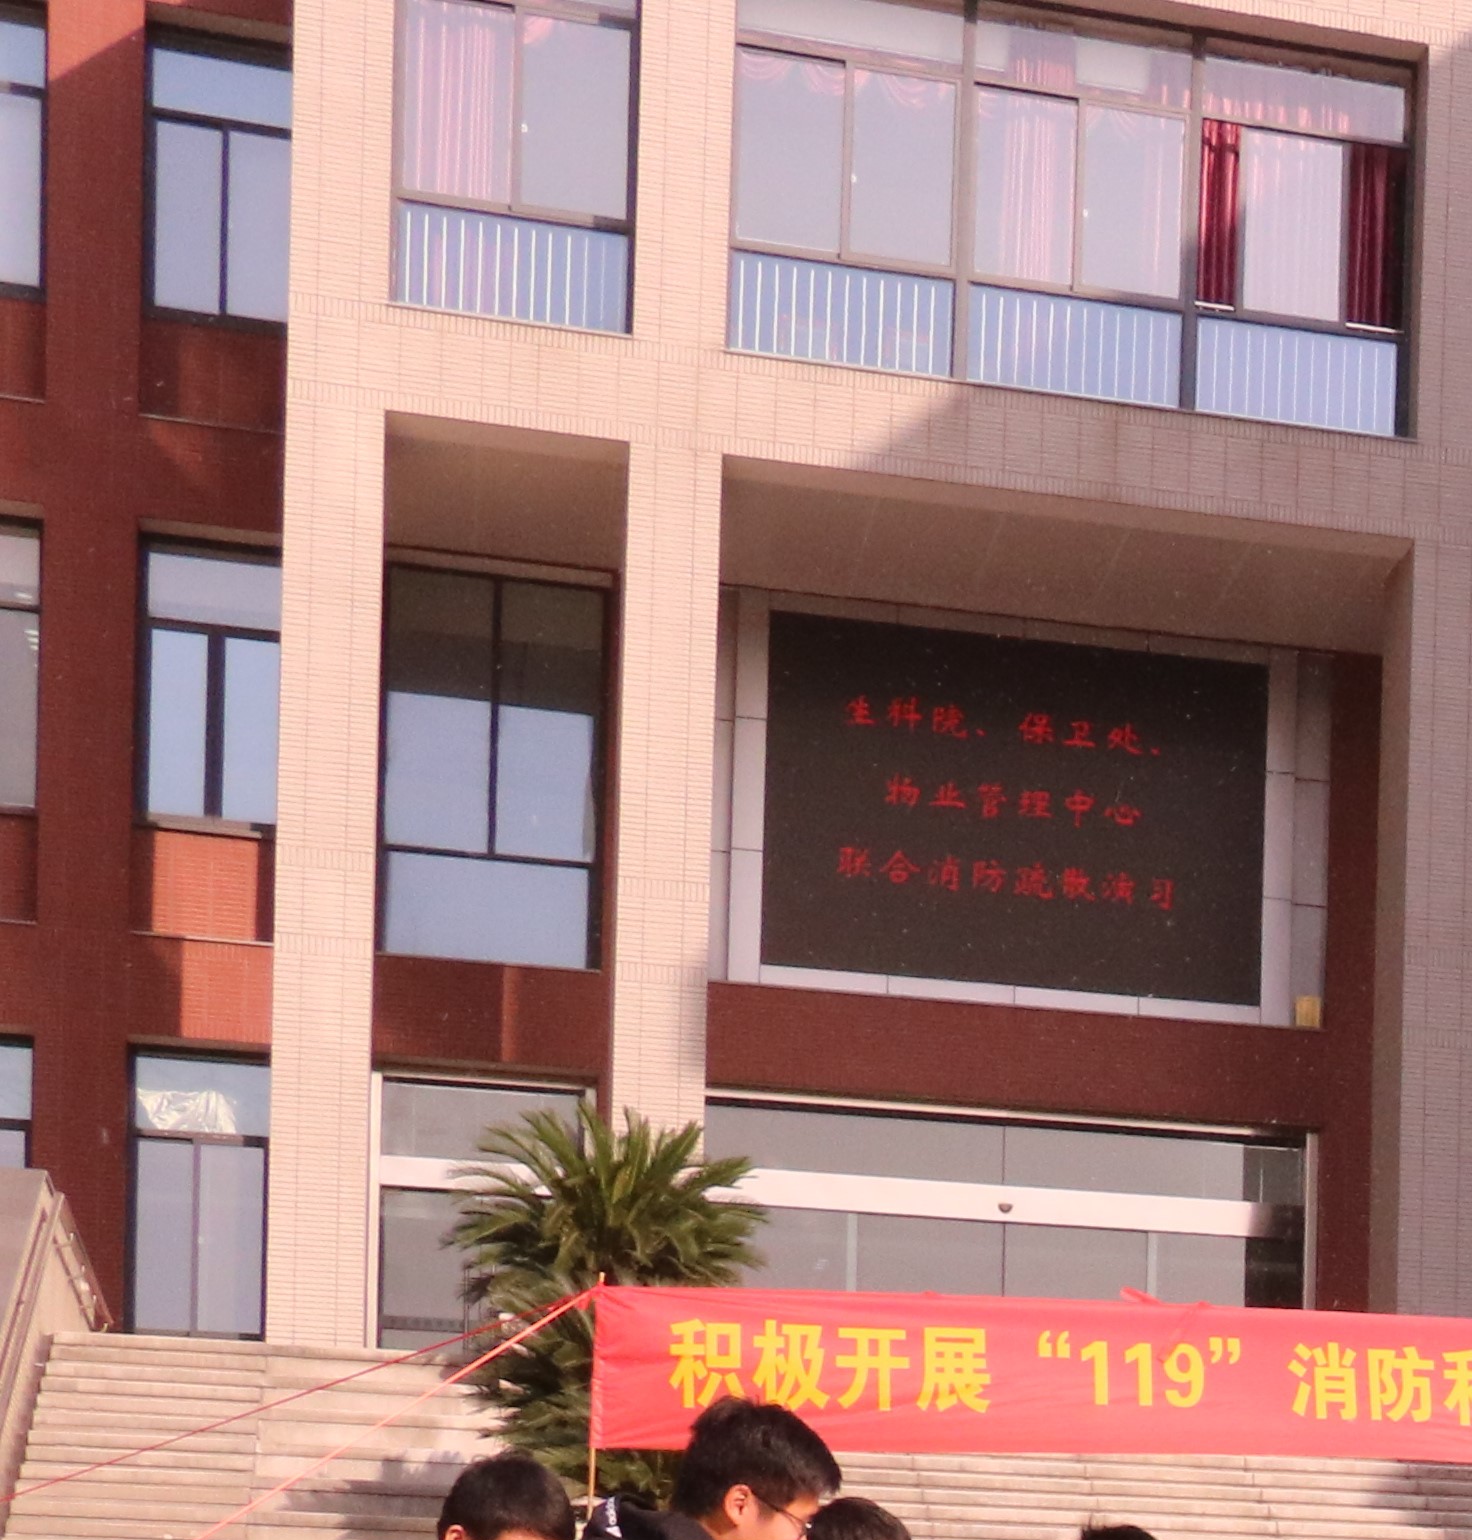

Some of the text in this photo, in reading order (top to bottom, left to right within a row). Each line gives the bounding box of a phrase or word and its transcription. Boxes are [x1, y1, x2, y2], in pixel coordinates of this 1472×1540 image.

[884, 773, 1143, 828] 物业管理中心
[836, 845, 1176, 911] 联合消防疏散演习
[668, 1318, 991, 1412] 积极开展
